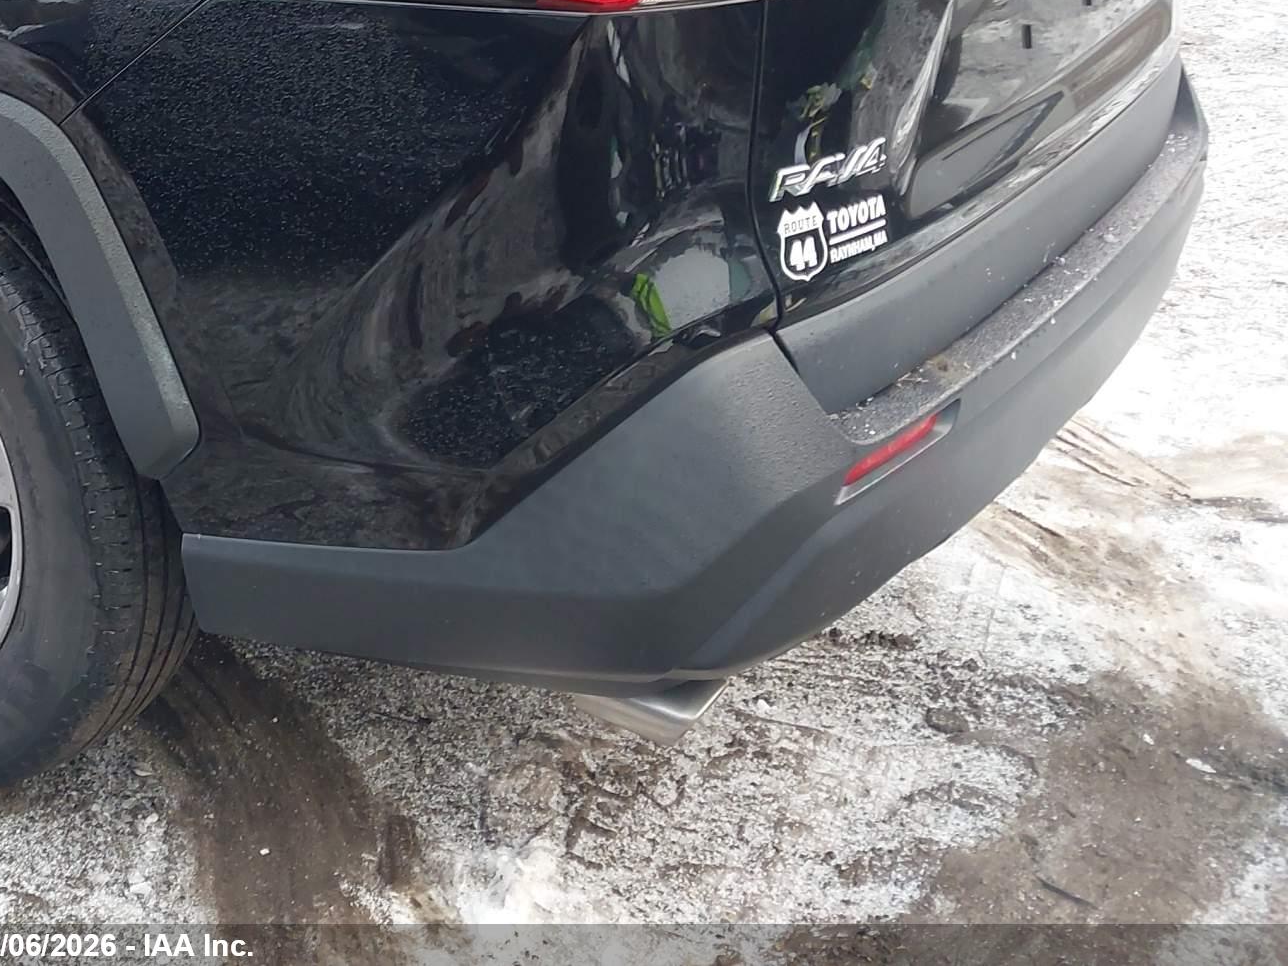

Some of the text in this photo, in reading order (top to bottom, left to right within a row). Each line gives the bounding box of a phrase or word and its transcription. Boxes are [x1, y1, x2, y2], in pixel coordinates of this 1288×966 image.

[768, 137, 888, 202] RAV4
[783, 214, 819, 235] ROUTE
[826, 194, 887, 234] TOYOTA
[789, 235, 819, 272] 44
